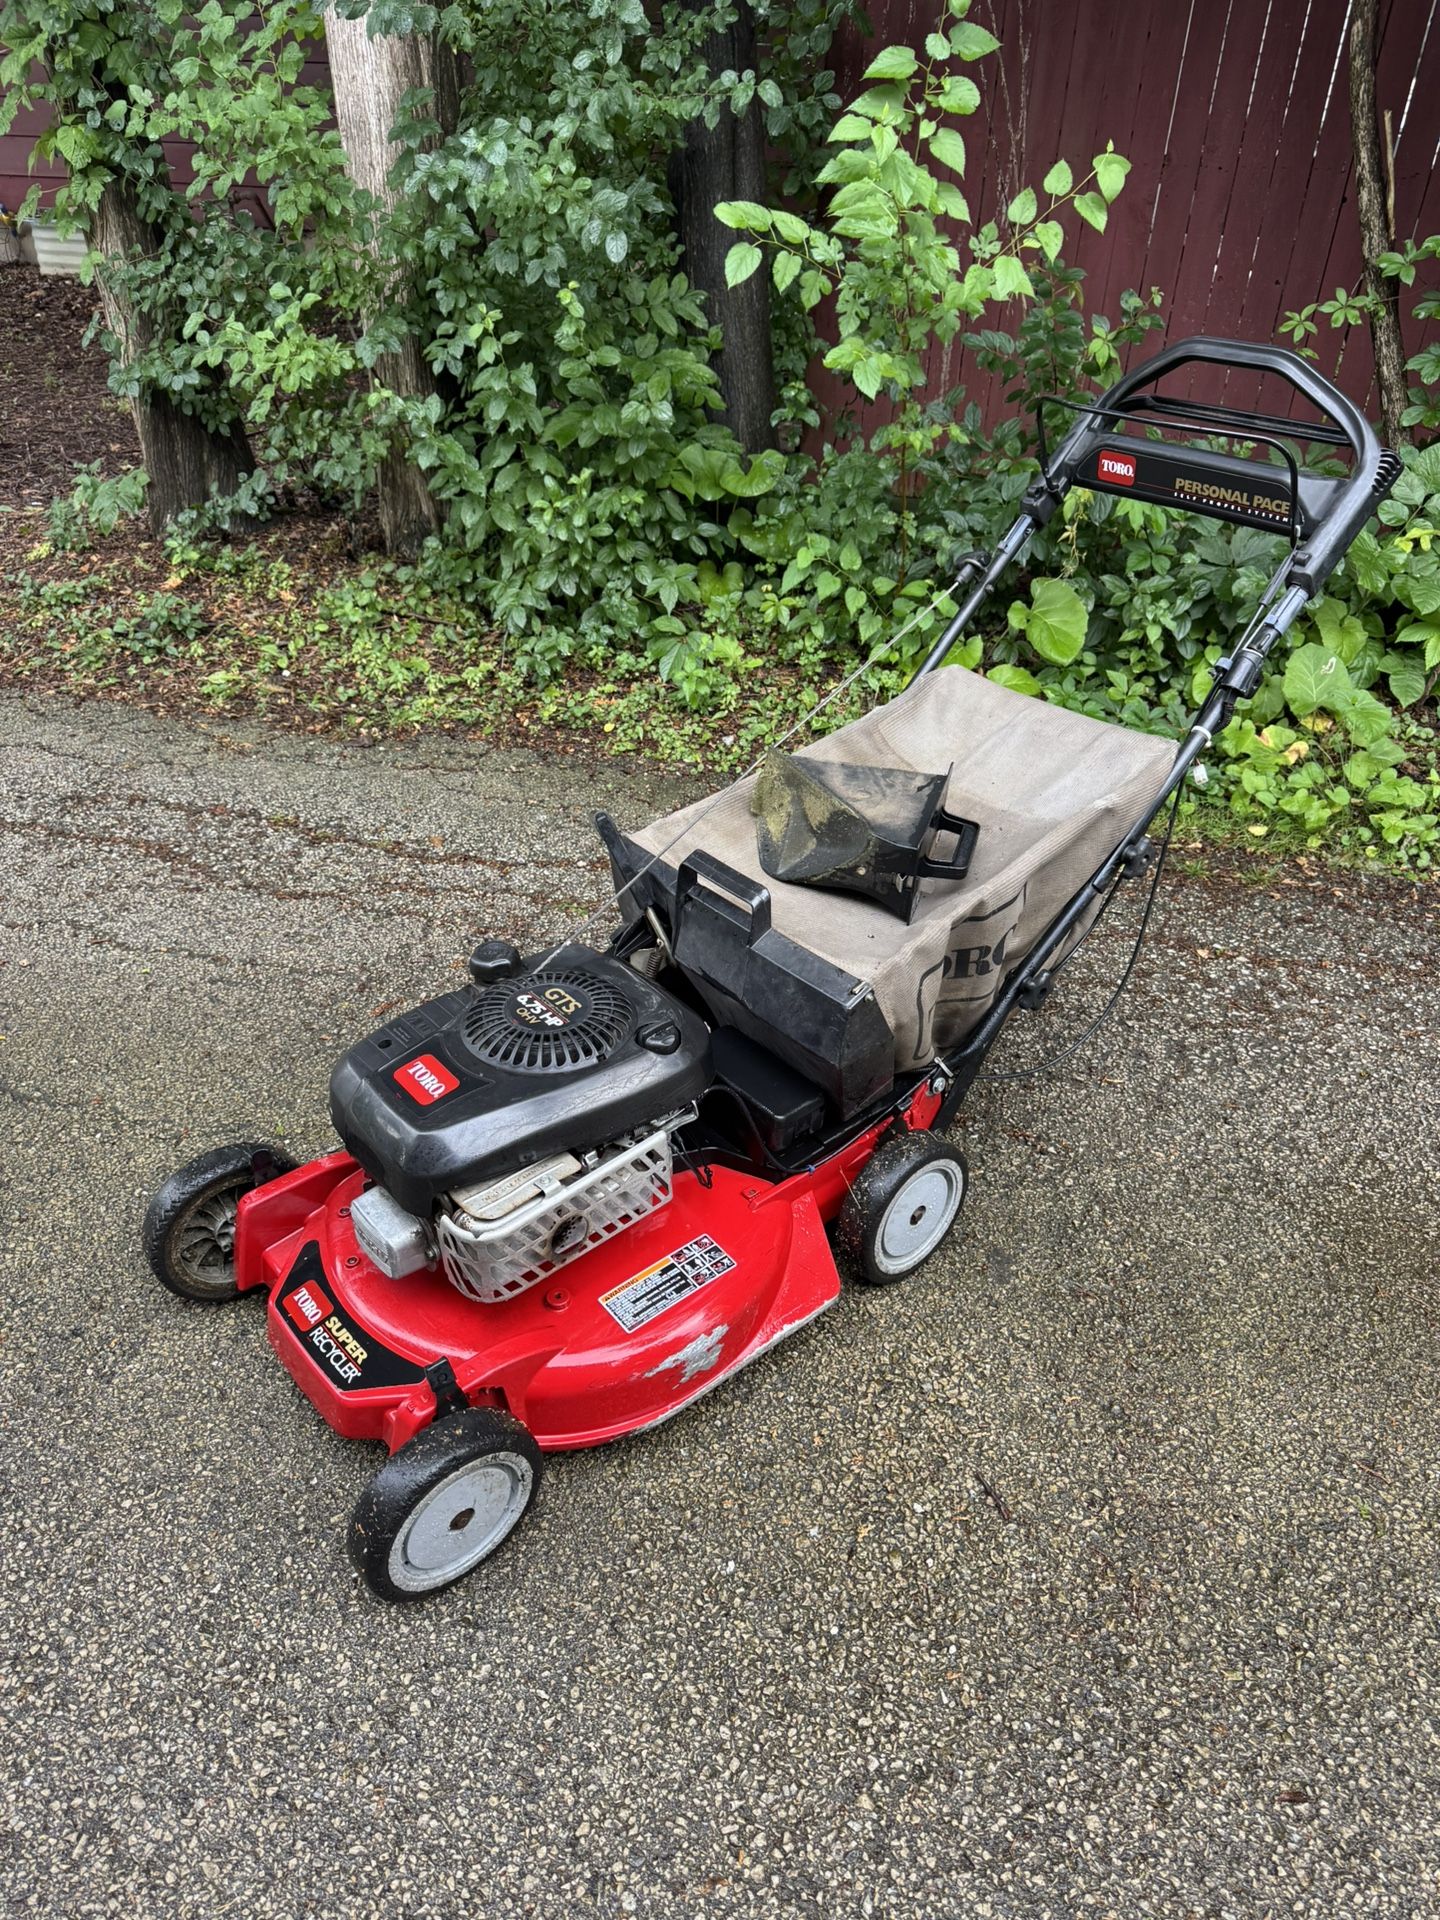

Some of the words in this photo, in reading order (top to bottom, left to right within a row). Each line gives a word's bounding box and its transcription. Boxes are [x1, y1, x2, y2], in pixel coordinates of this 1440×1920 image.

[1102, 459, 1134, 477] TORO
[1174, 492, 1197, 501] SELF
[1202, 498, 1241, 512] PROPEL
[1248, 508, 1289, 522] SYSTEM
[1175, 478, 1250, 505] PERSONAL
[1253, 495, 1290, 514] PACE
[516, 1007, 541, 1024] OHV
[517, 994, 547, 1014] 6.75
[539, 1012, 564, 1026] HP
[544, 988, 583, 1014] GTS
[407, 1060, 446, 1099] TORO
[608, 1278, 639, 1300] WARNING
[293, 1287, 322, 1324] TORO
[309, 1326, 360, 1384] RECYCLER
[325, 1316, 368, 1366] SUPER
